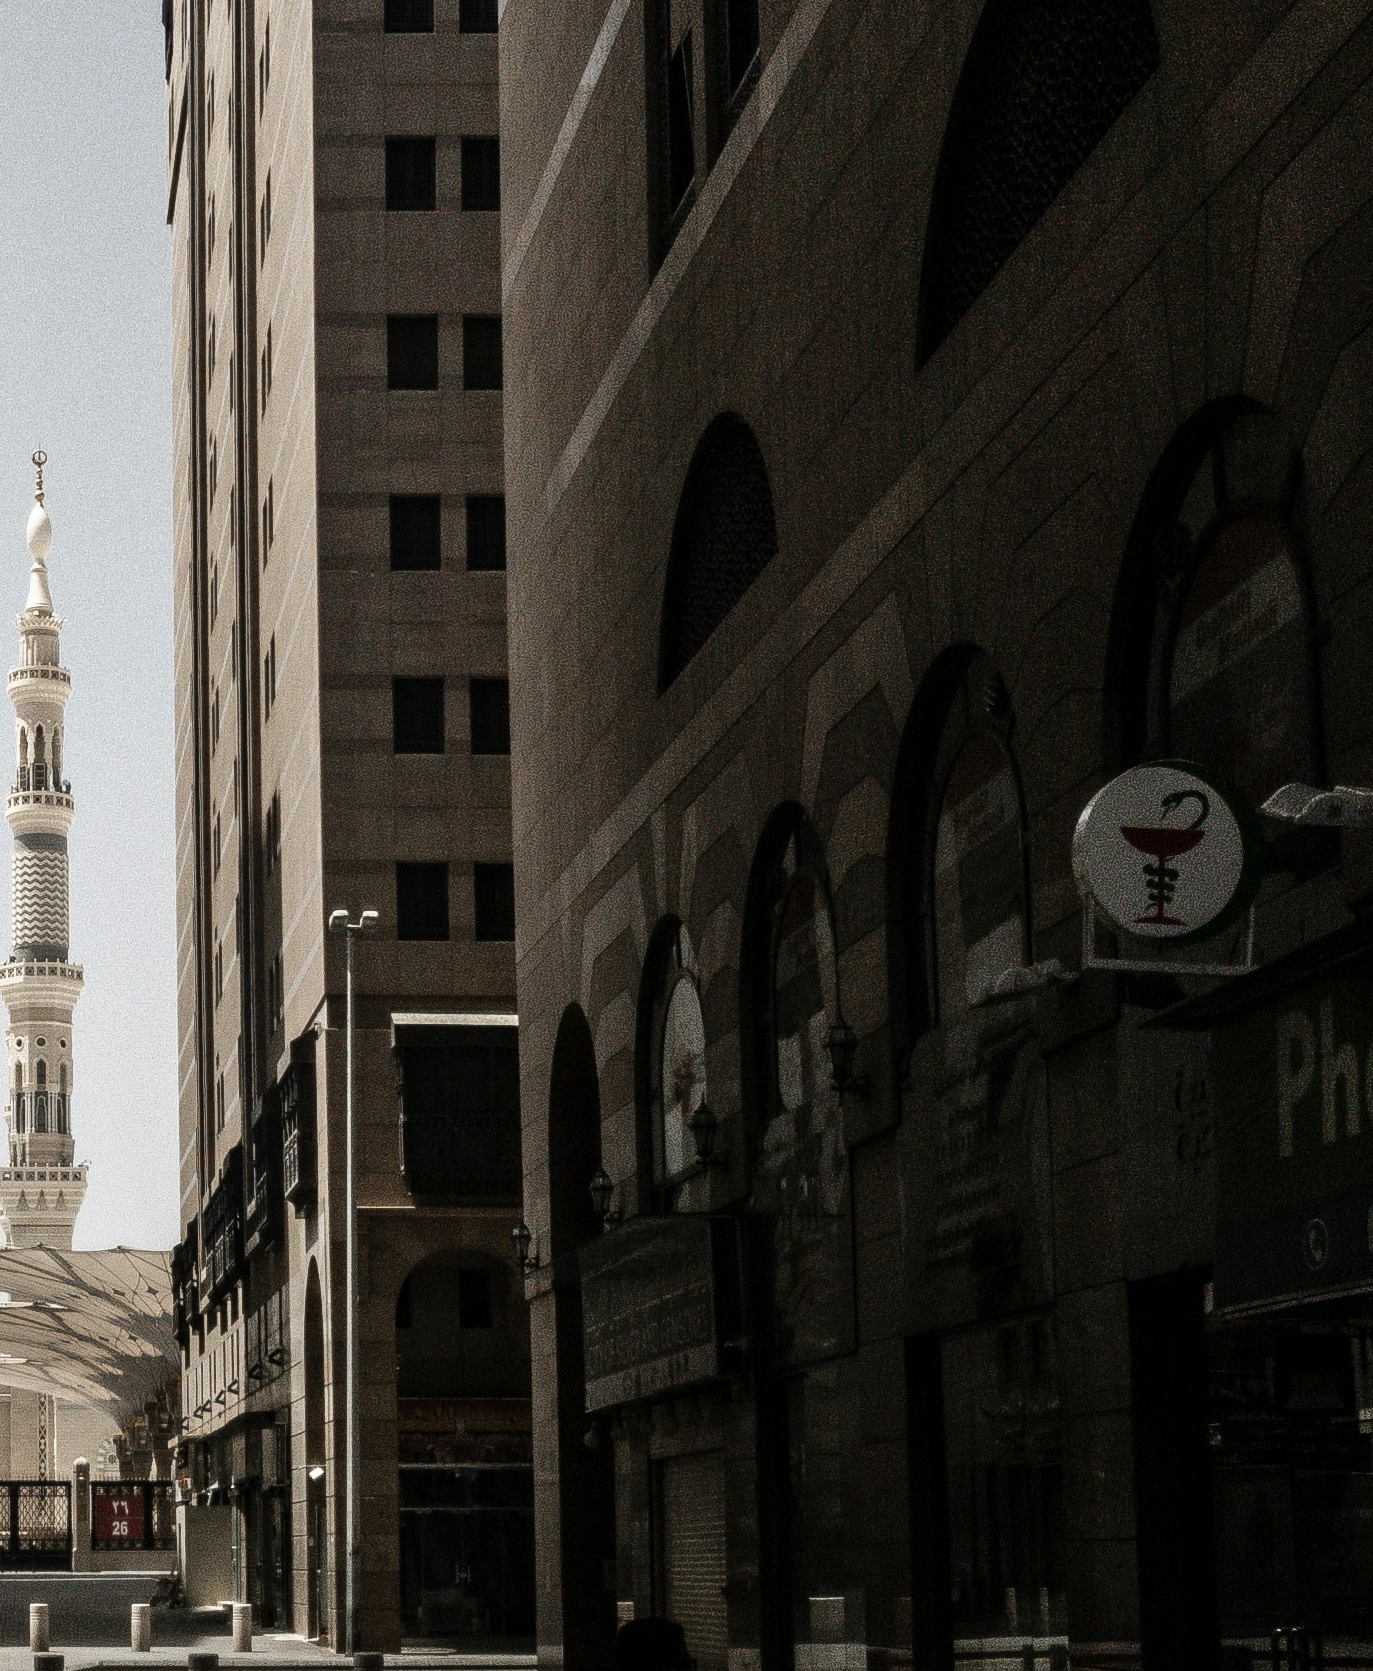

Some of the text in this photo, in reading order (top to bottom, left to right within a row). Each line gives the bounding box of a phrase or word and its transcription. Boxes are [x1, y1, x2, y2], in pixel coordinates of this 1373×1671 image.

[1276, 994, 1373, 1158] Ph
[111, 1500, 129, 1515] ٢٦
[112, 1521, 129, 1536] 26
